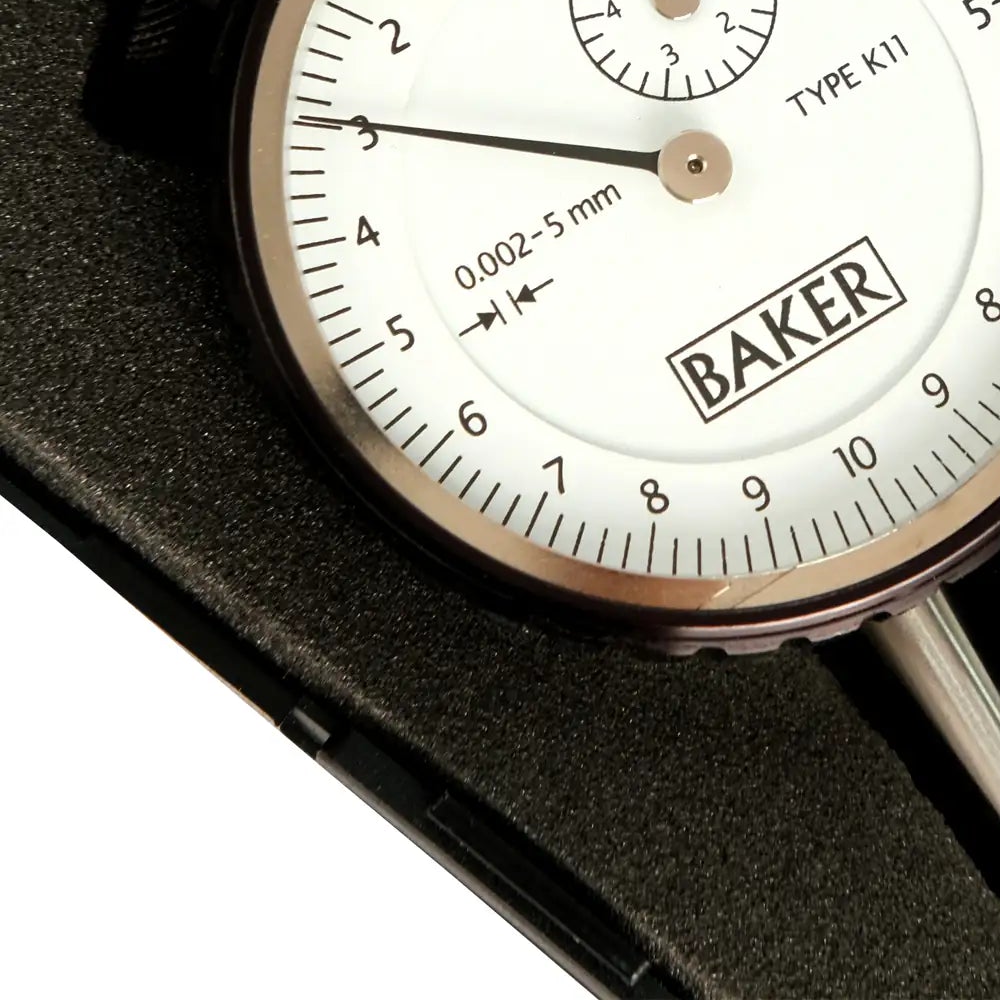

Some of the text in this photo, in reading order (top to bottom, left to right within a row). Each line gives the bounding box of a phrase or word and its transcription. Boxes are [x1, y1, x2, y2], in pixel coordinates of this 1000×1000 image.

[606, 0, 622, 19] 4
[715, 11, 736, 34] 2
[378, 18, 411, 55] 2
[660, 43, 680, 66] 3
[785, 34, 909, 117] TYPE K11
[349, 114, 380, 151] 3
[567, 184, 622, 226] mm
[356, 215, 381, 247] 4
[385, 314, 415, 352] 5
[680, 261, 893, 409] BAKER
[921, 372, 950, 409] 9
[458, 400, 488, 437] 6
[542, 455, 565, 495] 7
[832, 436, 877, 478] 10
[639, 478, 670, 515] 8
[742, 475, 771, 512] 9
